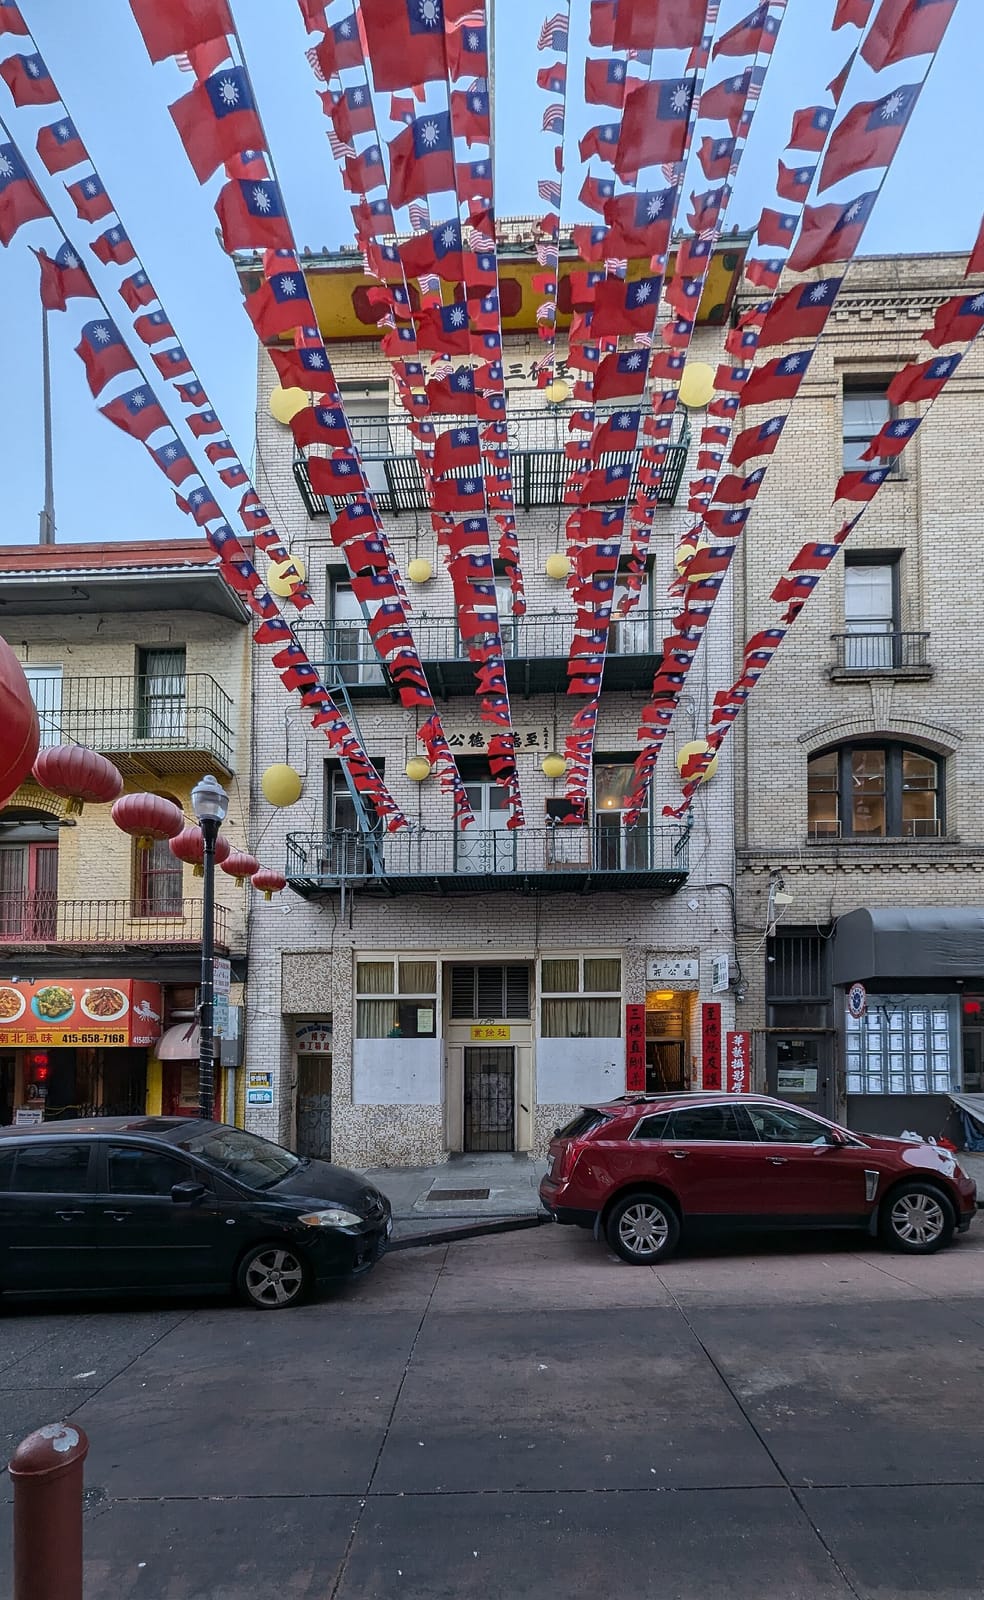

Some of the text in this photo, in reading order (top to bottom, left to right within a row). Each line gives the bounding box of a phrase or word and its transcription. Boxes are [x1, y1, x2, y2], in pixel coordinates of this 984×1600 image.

[0, 1033, 53, 1043] 南北風味
[62, 1034, 125, 1043] 415-658-7168
